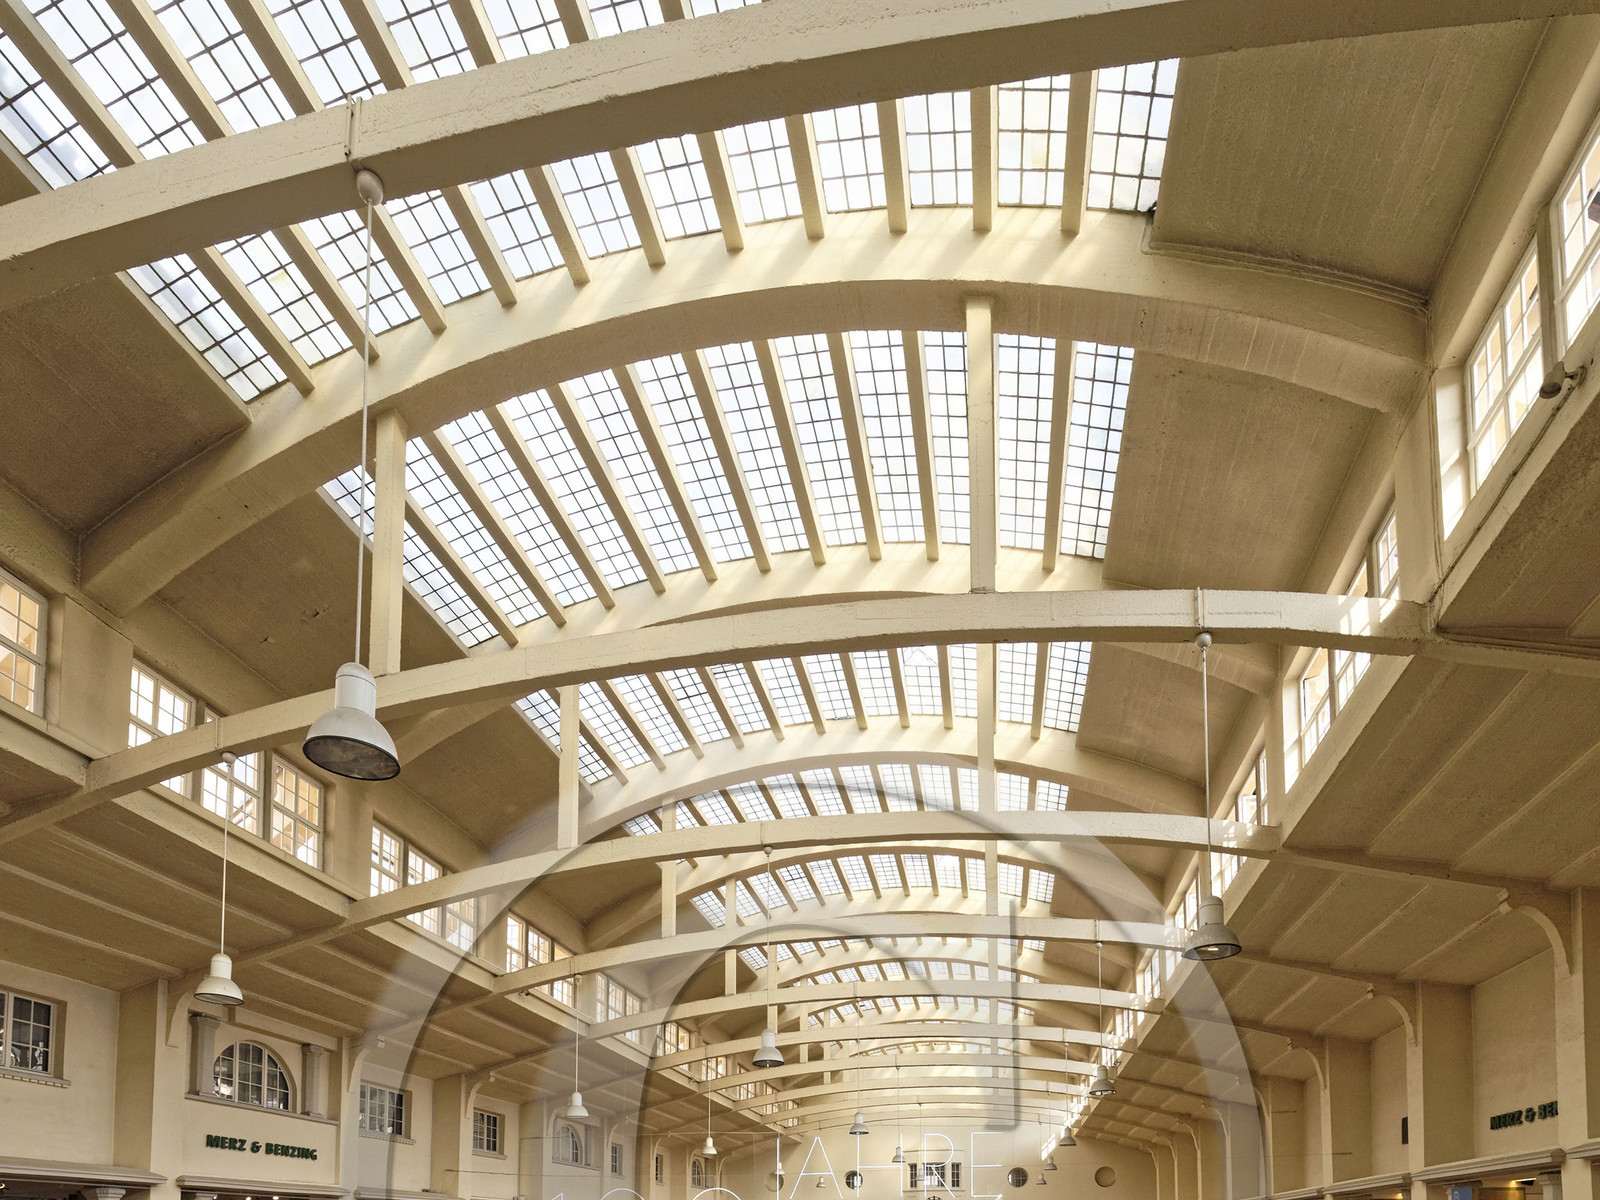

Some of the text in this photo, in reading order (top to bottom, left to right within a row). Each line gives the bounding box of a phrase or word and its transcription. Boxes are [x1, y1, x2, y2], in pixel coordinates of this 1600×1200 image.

[1490, 1109, 1523, 1130] MERZ
[1525, 1107, 1536, 1122] &
[206, 1134, 318, 1161] MERZ & BENZING
